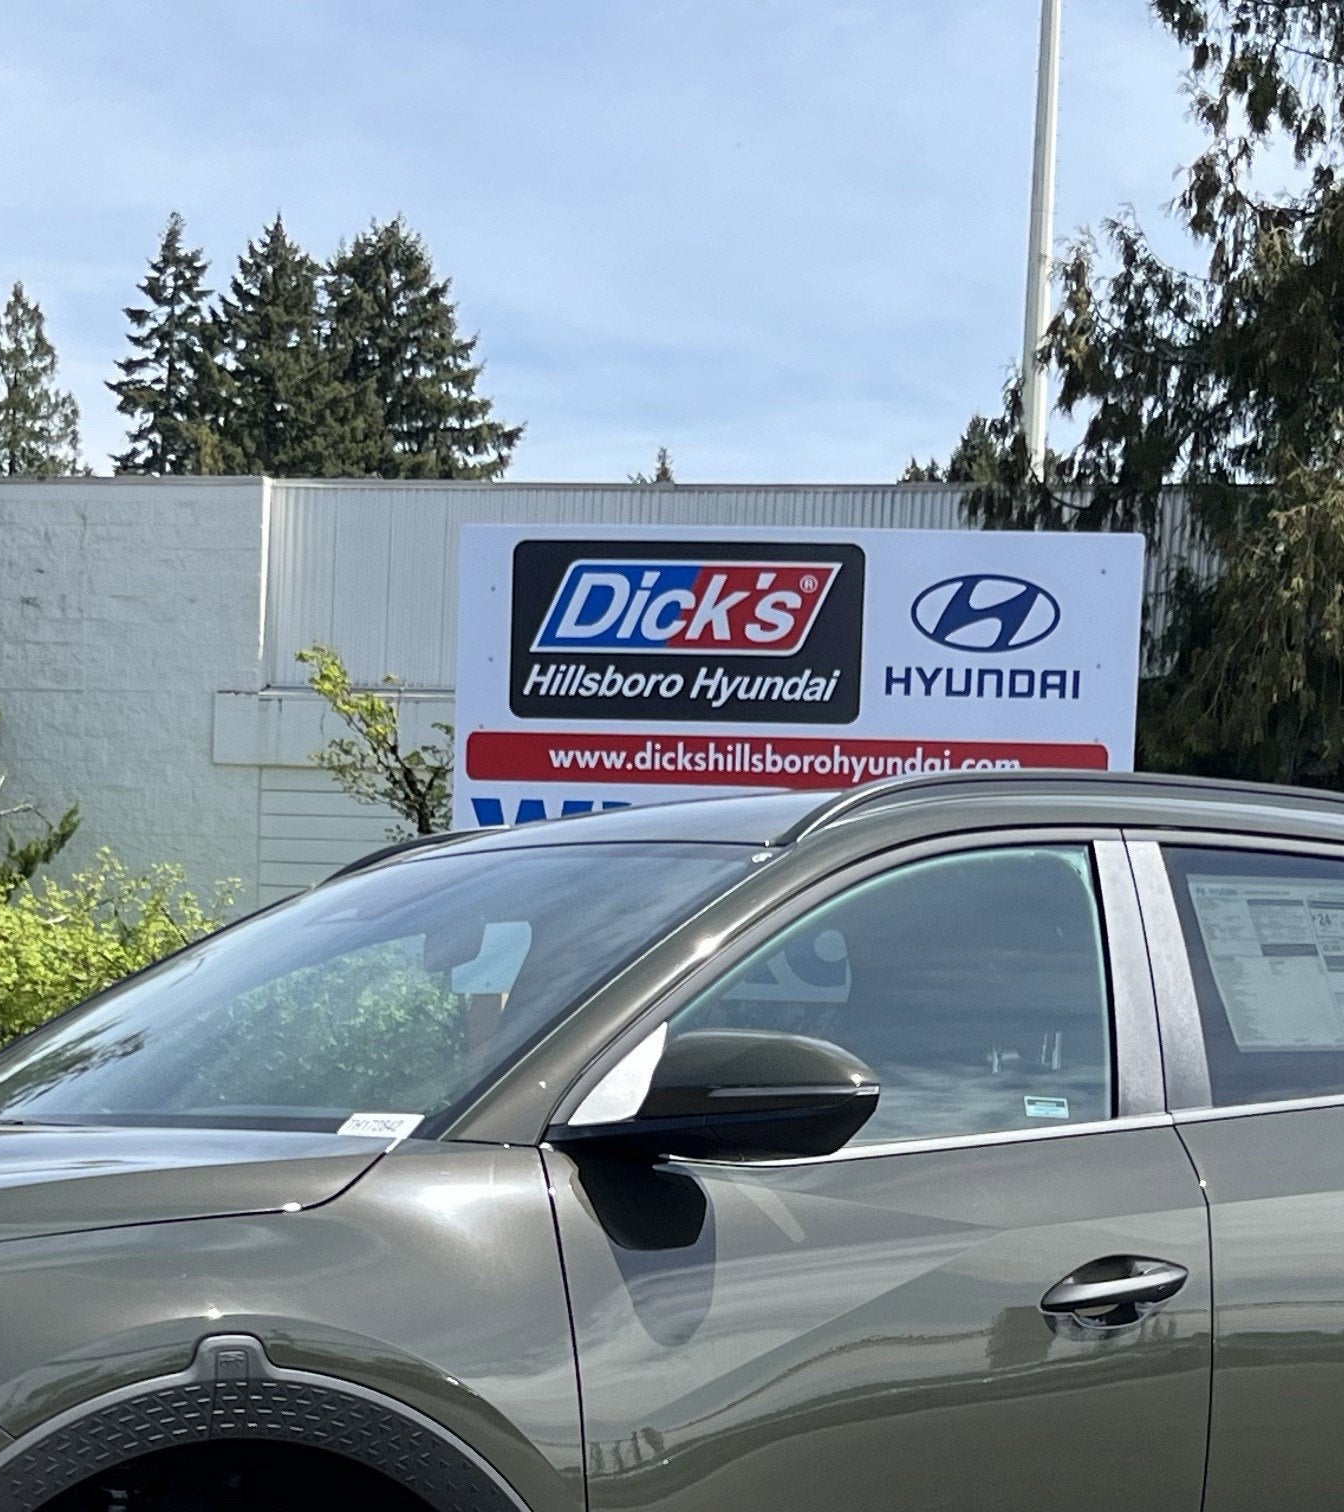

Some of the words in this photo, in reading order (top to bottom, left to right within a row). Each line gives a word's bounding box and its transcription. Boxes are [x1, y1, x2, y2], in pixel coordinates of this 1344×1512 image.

[554, 570, 804, 645] Dick's
[522, 663, 684, 699] Hillsboro
[690, 666, 839, 707] Hyundai
[885, 666, 1080, 700] HYUNDAI
